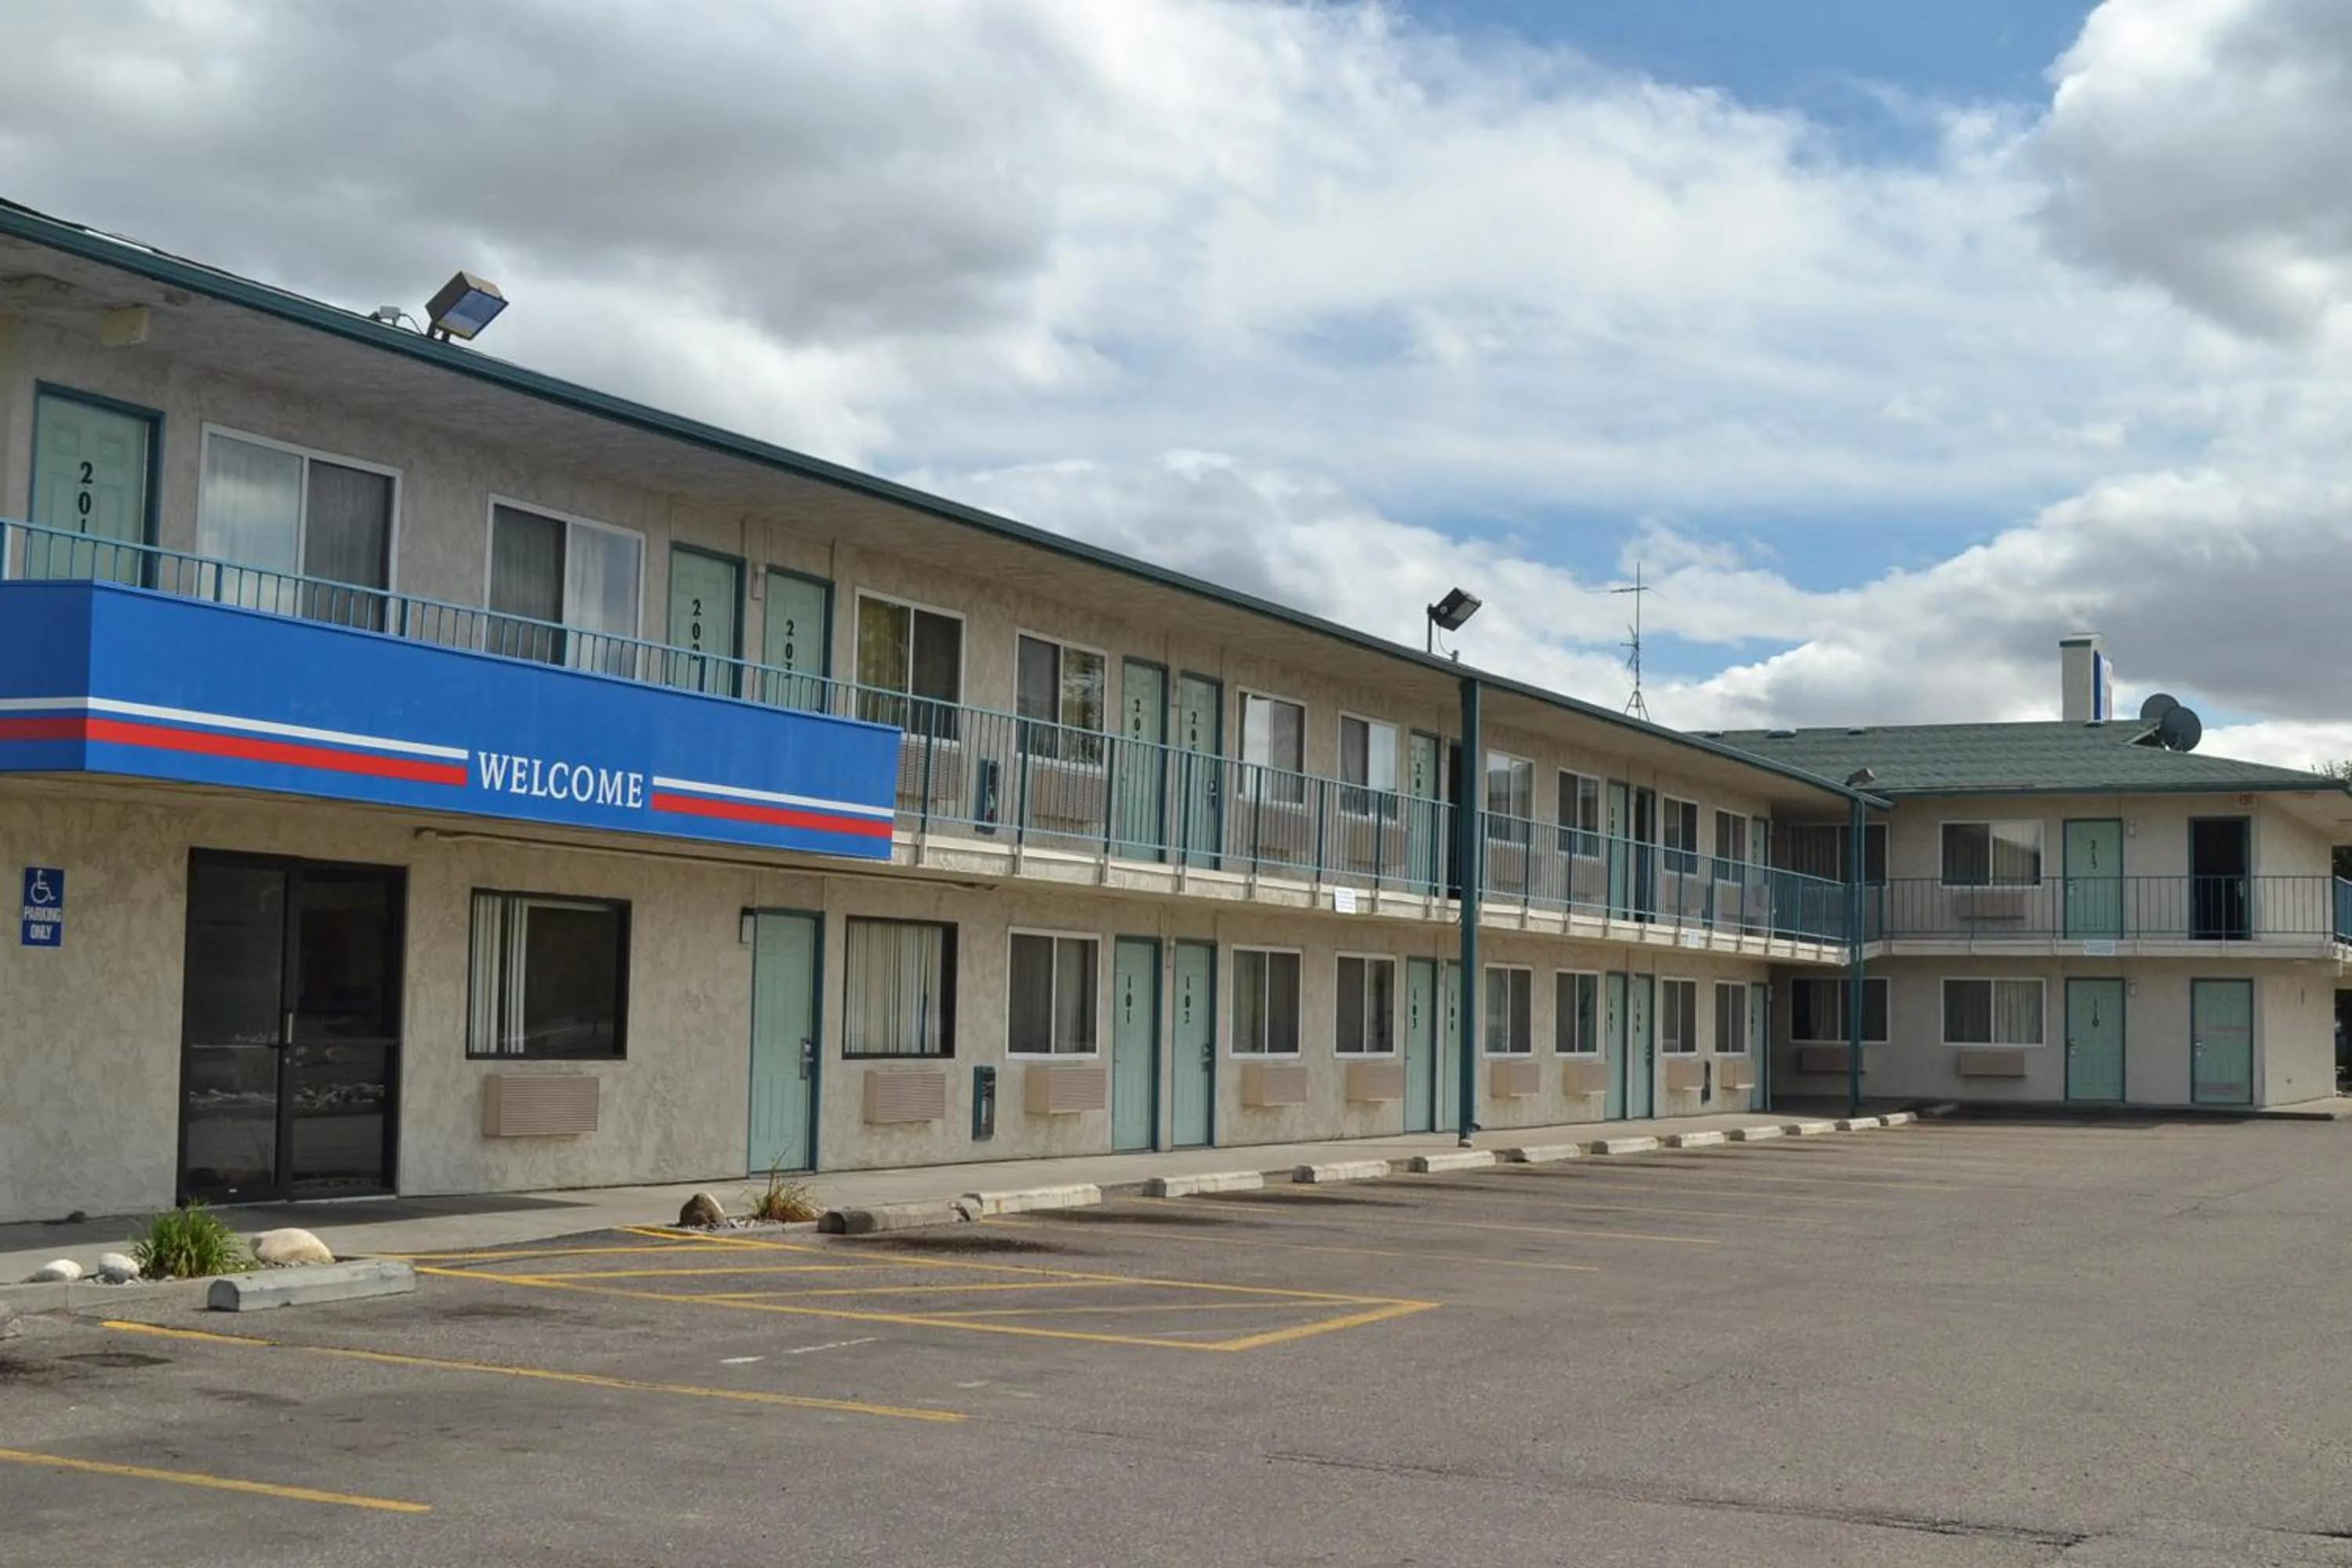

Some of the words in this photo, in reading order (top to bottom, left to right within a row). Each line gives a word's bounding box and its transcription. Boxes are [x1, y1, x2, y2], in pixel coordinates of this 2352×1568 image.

[477, 750, 644, 809] WELCOME
[24, 906, 62, 922] PARKING
[30, 924, 53, 940] ONLY
